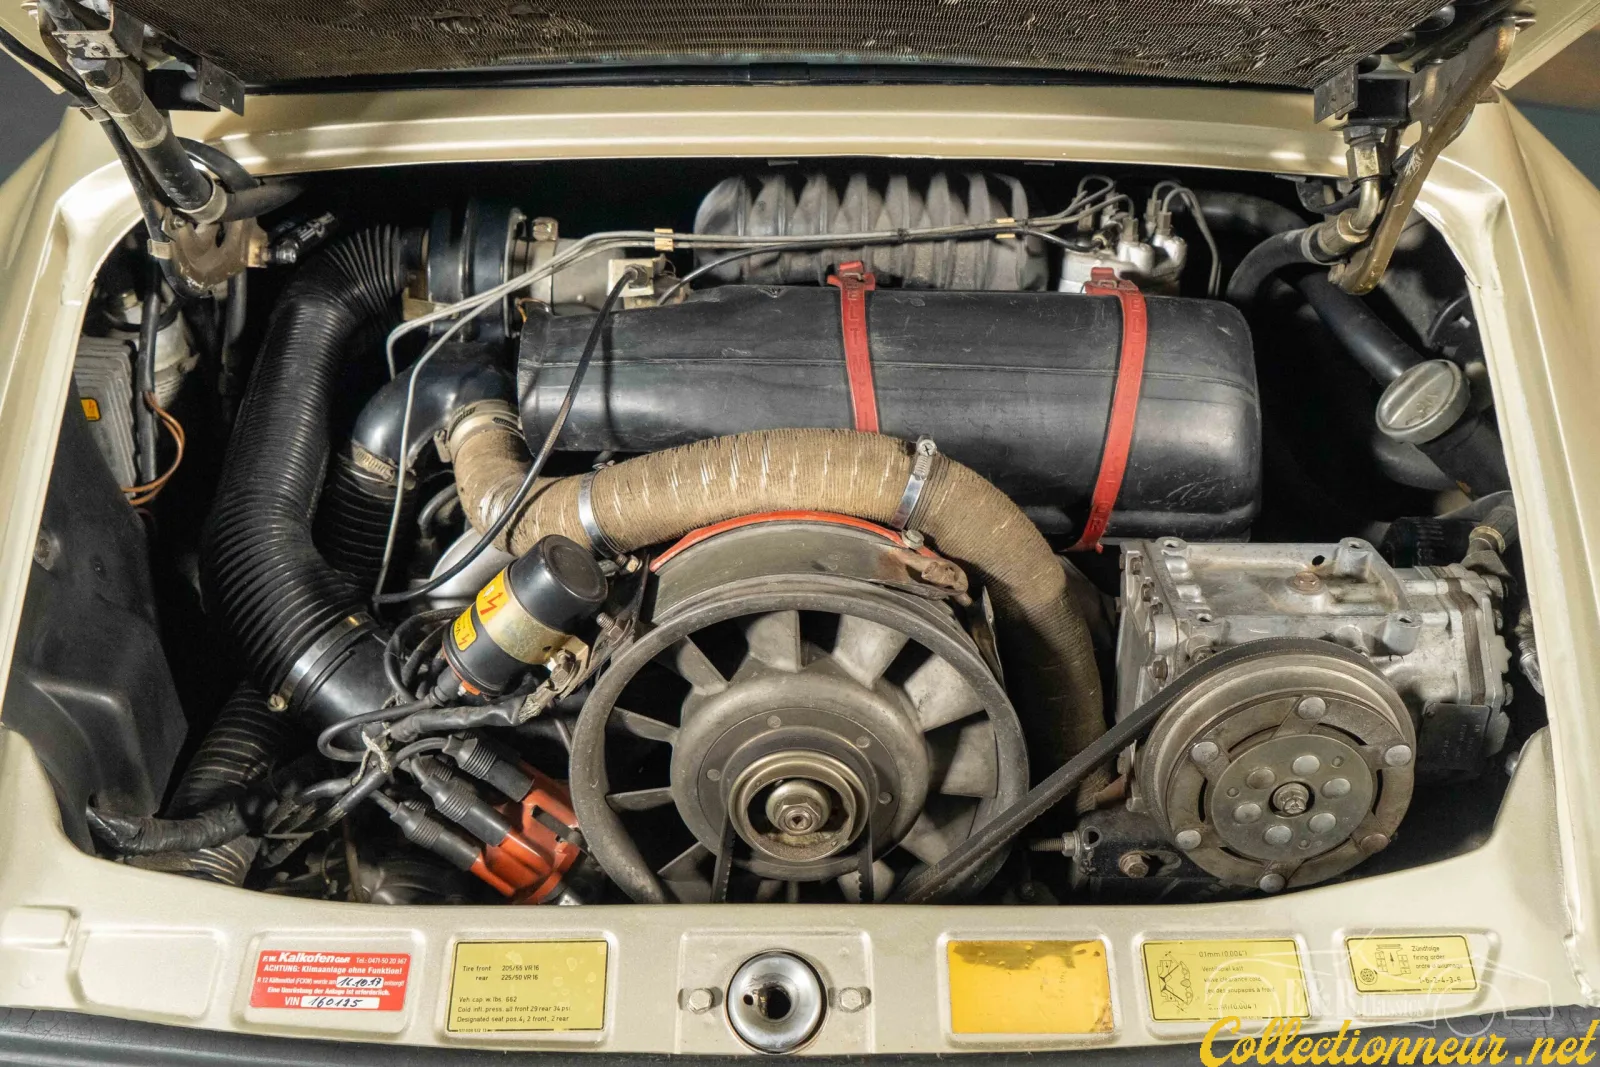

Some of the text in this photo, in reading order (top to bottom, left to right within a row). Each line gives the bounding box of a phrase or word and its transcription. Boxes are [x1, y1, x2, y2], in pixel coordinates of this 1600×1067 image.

[278, 952, 335, 963] Kalkofen
[263, 964, 300, 972] ACHTUNG:
[301, 965, 346, 975] Klimaanlage
[367, 967, 402, 975] Funktion!
[284, 996, 300, 1006] VIN
